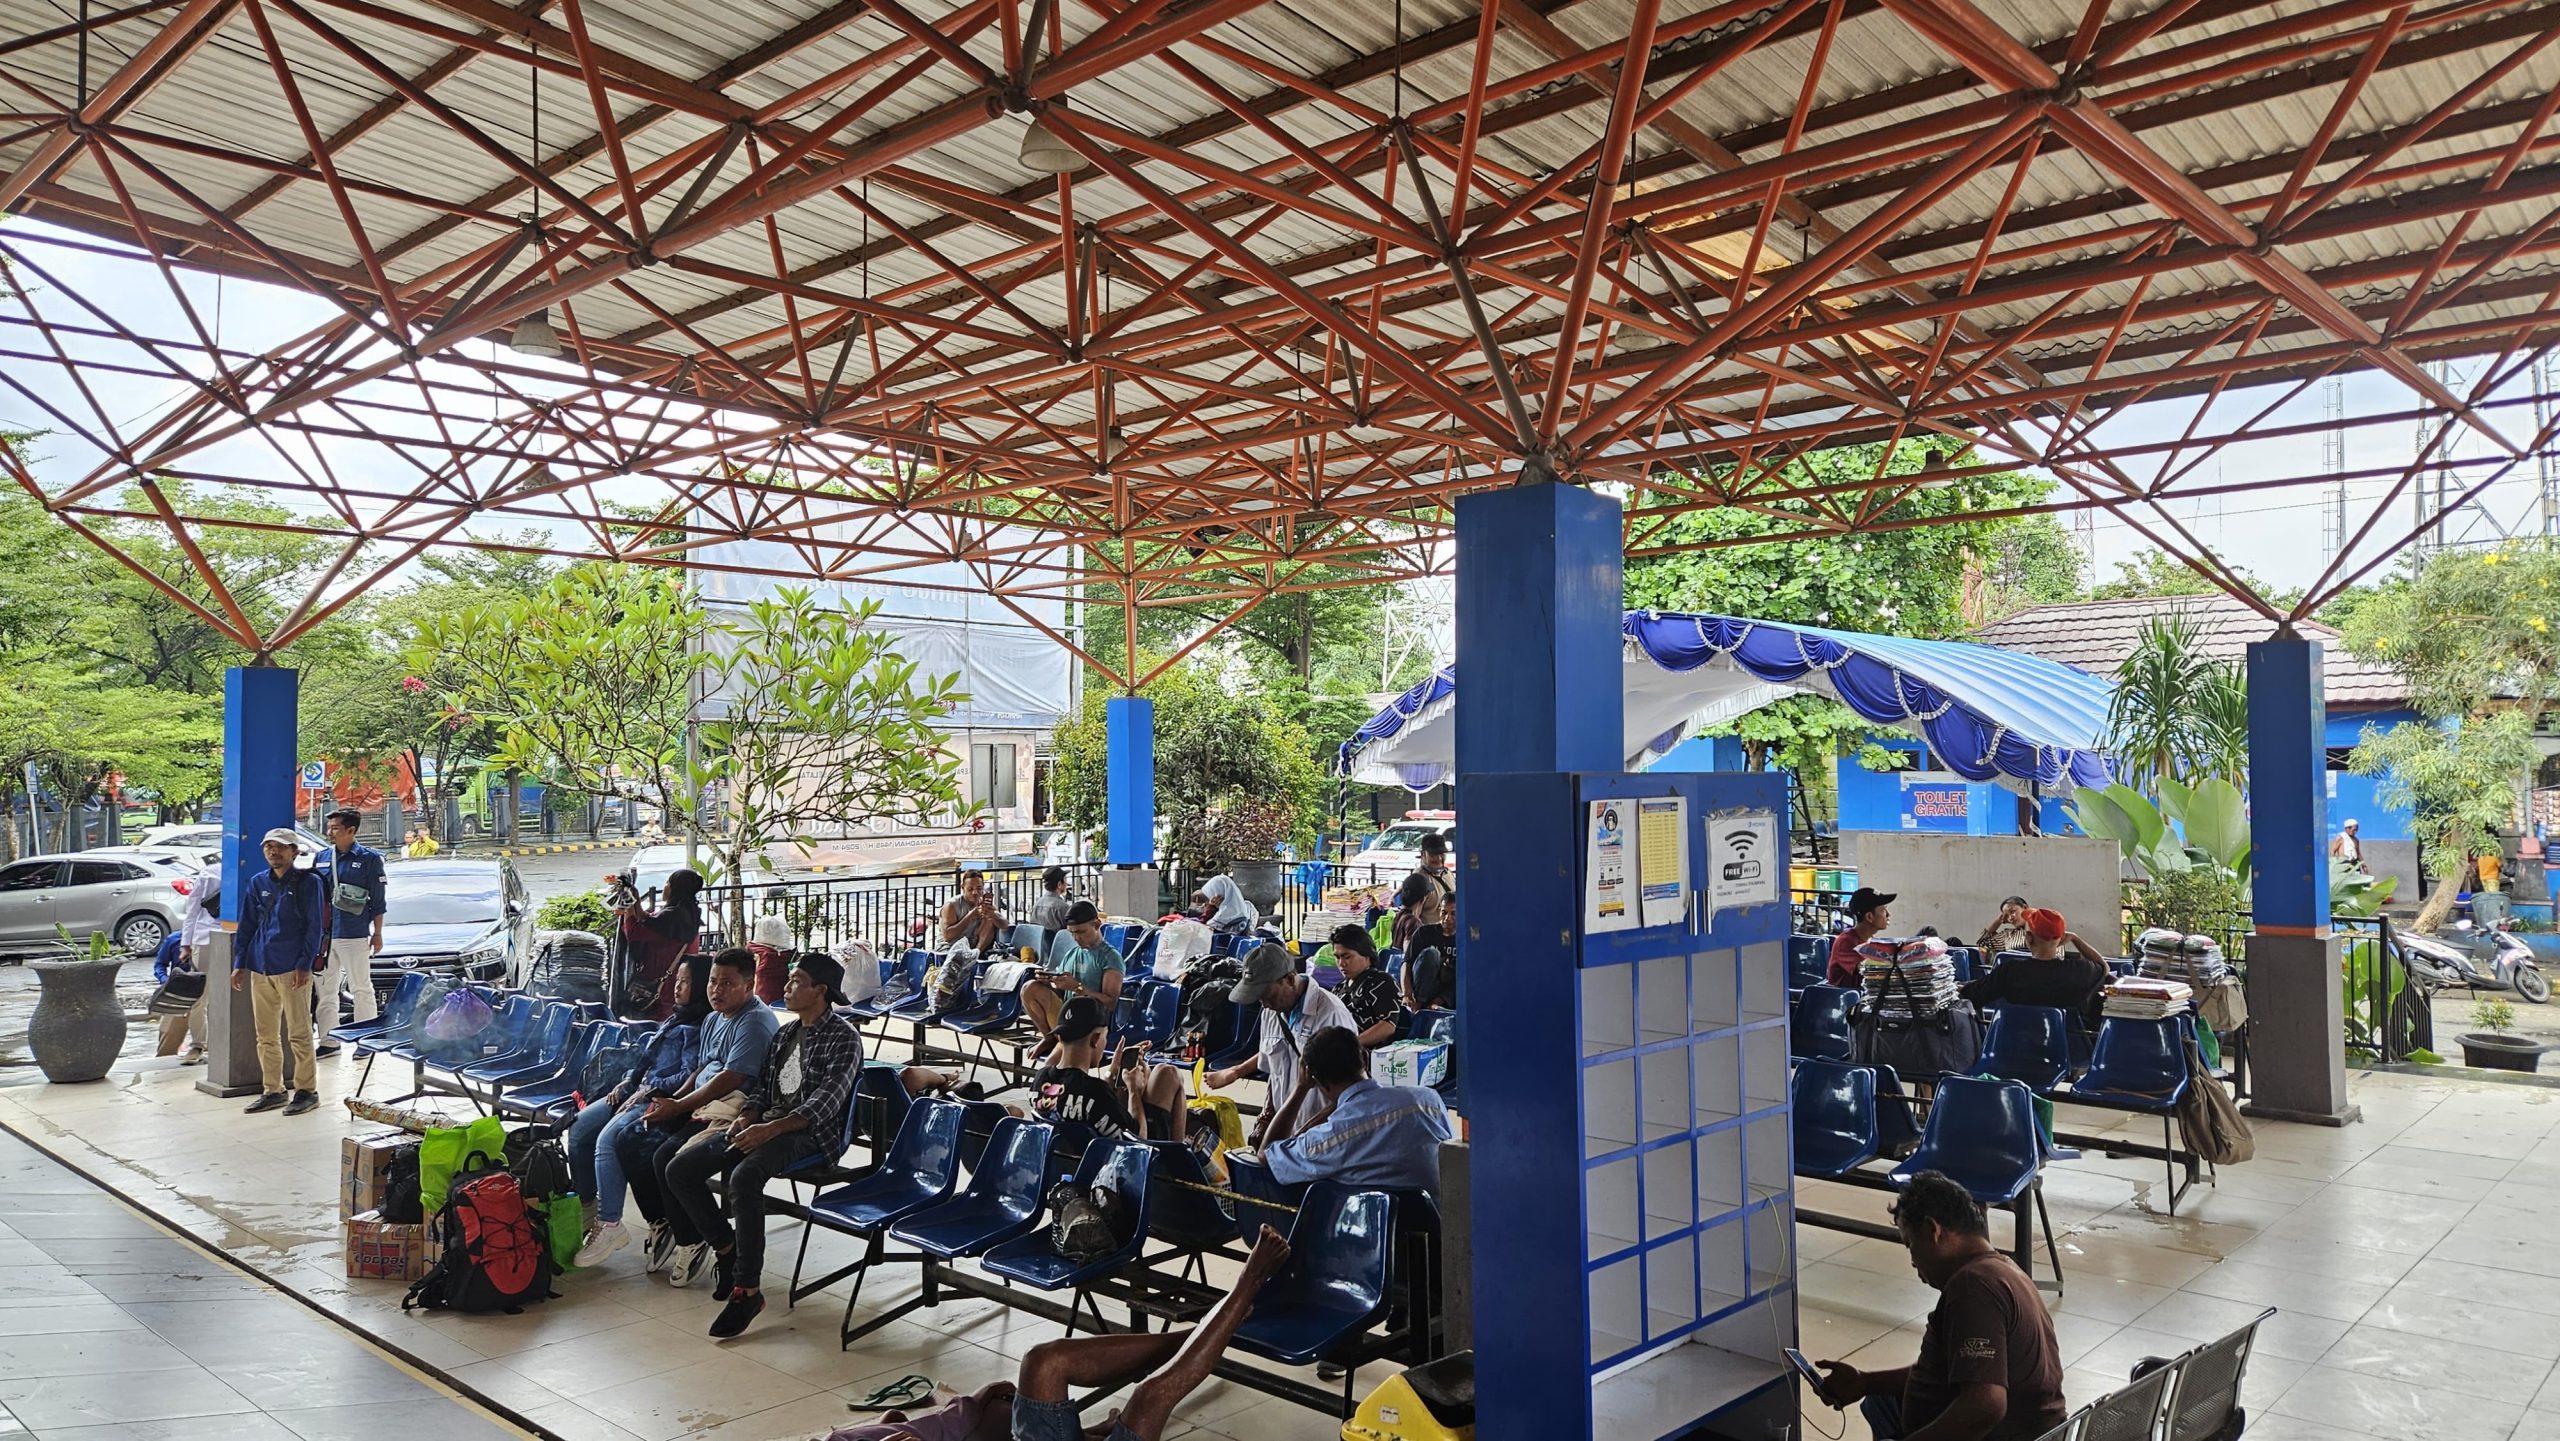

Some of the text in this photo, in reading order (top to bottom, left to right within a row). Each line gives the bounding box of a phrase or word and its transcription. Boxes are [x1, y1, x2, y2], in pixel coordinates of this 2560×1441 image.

[1914, 791, 1967, 804] TOILET
[1915, 804, 1968, 817] GRATIS
[1725, 867, 1741, 877] FREE
[1379, 1064, 1408, 1075] Trubus
